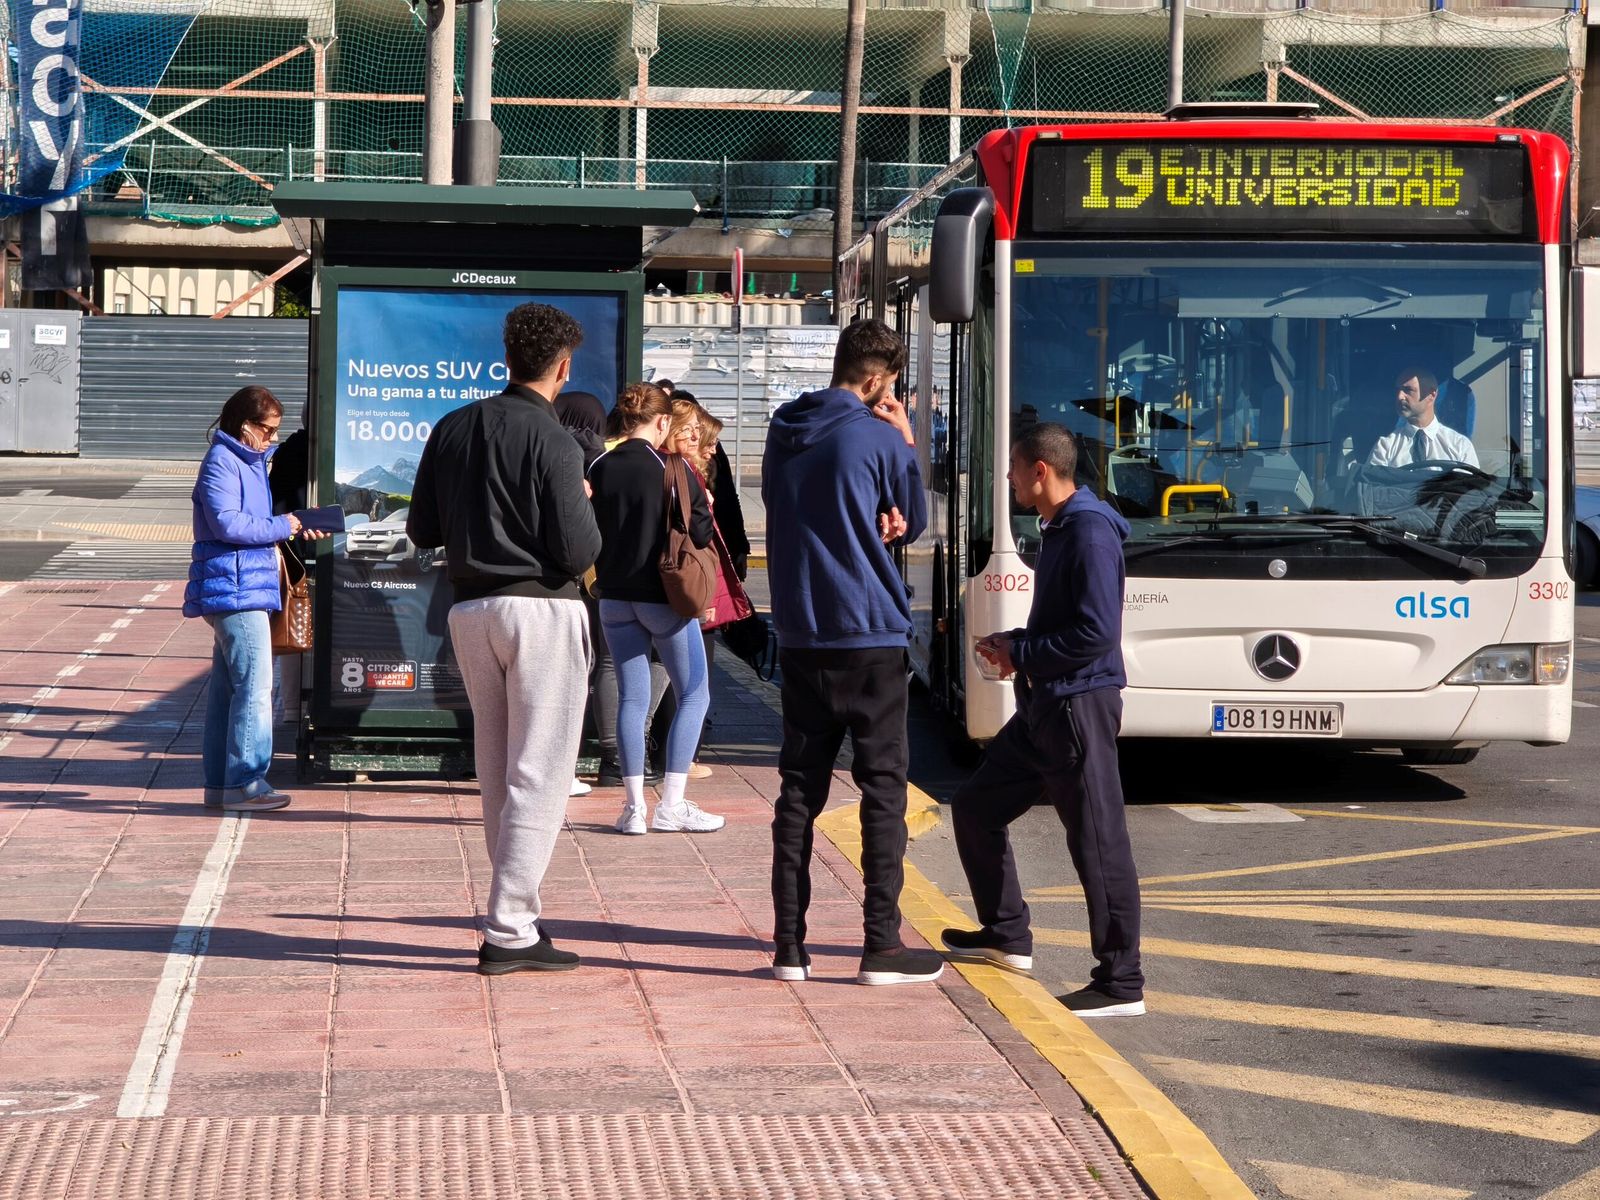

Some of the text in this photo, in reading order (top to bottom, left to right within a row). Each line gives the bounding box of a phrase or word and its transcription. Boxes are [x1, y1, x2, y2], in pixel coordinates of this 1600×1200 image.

[1082, 148, 1154, 208] 19
[1167, 178, 1460, 206] UNIVERSIDAD
[452, 272, 517, 285] JCDecaux
[348, 358, 429, 379] Nuevos
[436, 360, 483, 381] SUV
[347, 384, 378, 397] Una
[382, 387, 423, 401] gama
[427, 389, 436, 399] a
[440, 387, 456, 400] tu
[347, 409, 364, 418] Elige
[372, 410, 388, 418] tuyo
[347, 420, 432, 442] 18.000
[343, 581, 417, 590] Nuevo C5 Aircross
[984, 574, 1029, 592] 3302
[1529, 582, 1569, 600] 3302
[1123, 592, 1169, 603] LMERÍA
[1395, 591, 1470, 618] alsa
[341, 662, 364, 688] 8
